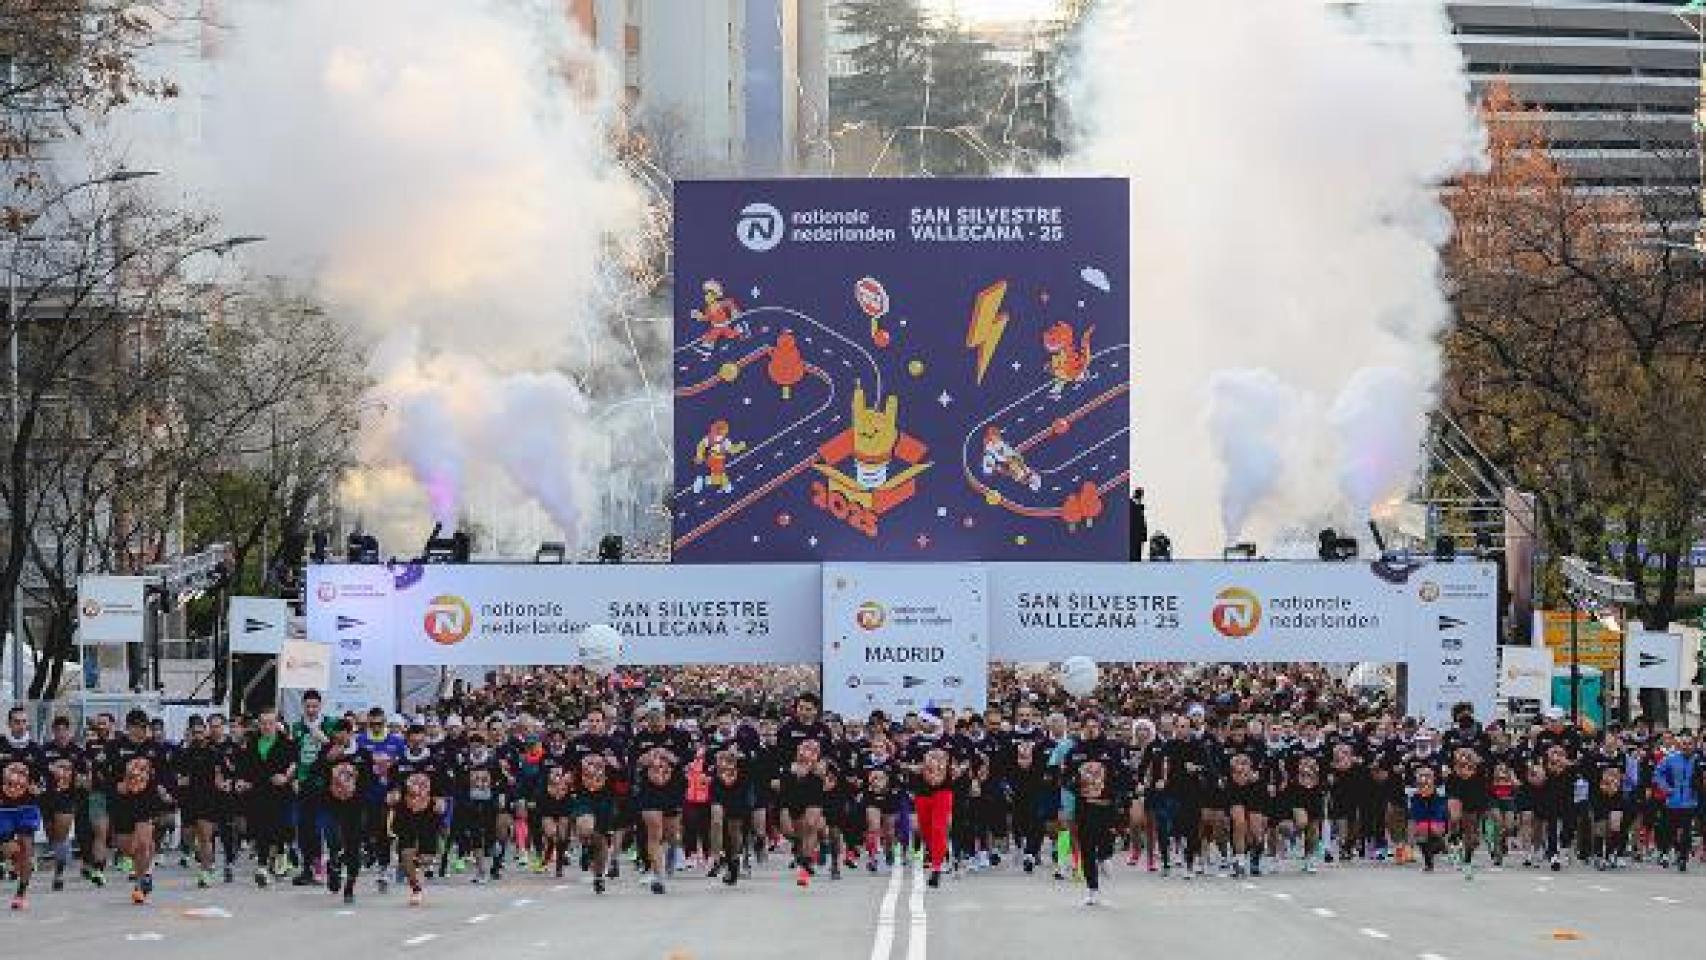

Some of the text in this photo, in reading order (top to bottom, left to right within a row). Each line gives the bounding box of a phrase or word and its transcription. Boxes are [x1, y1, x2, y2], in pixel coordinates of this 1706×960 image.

[791, 208, 870, 224] nationale
[911, 207, 1062, 224] SAN SILVESTRE
[791, 225, 896, 241] nederlanden
[911, 225, 1025, 242] VALLECANA
[481, 601, 563, 617] nationale
[607, 601, 769, 617] SAN SILVESTRE
[1017, 592, 1179, 611] SAN SILVESTRE
[1269, 596, 1352, 611] nationale
[744, 620, 769, 636] 25
[1017, 612, 1137, 628] VALLECANA
[1155, 613, 1179, 628] 25
[1269, 612, 1380, 628] nederlanden
[865, 647, 944, 663] MADRID
